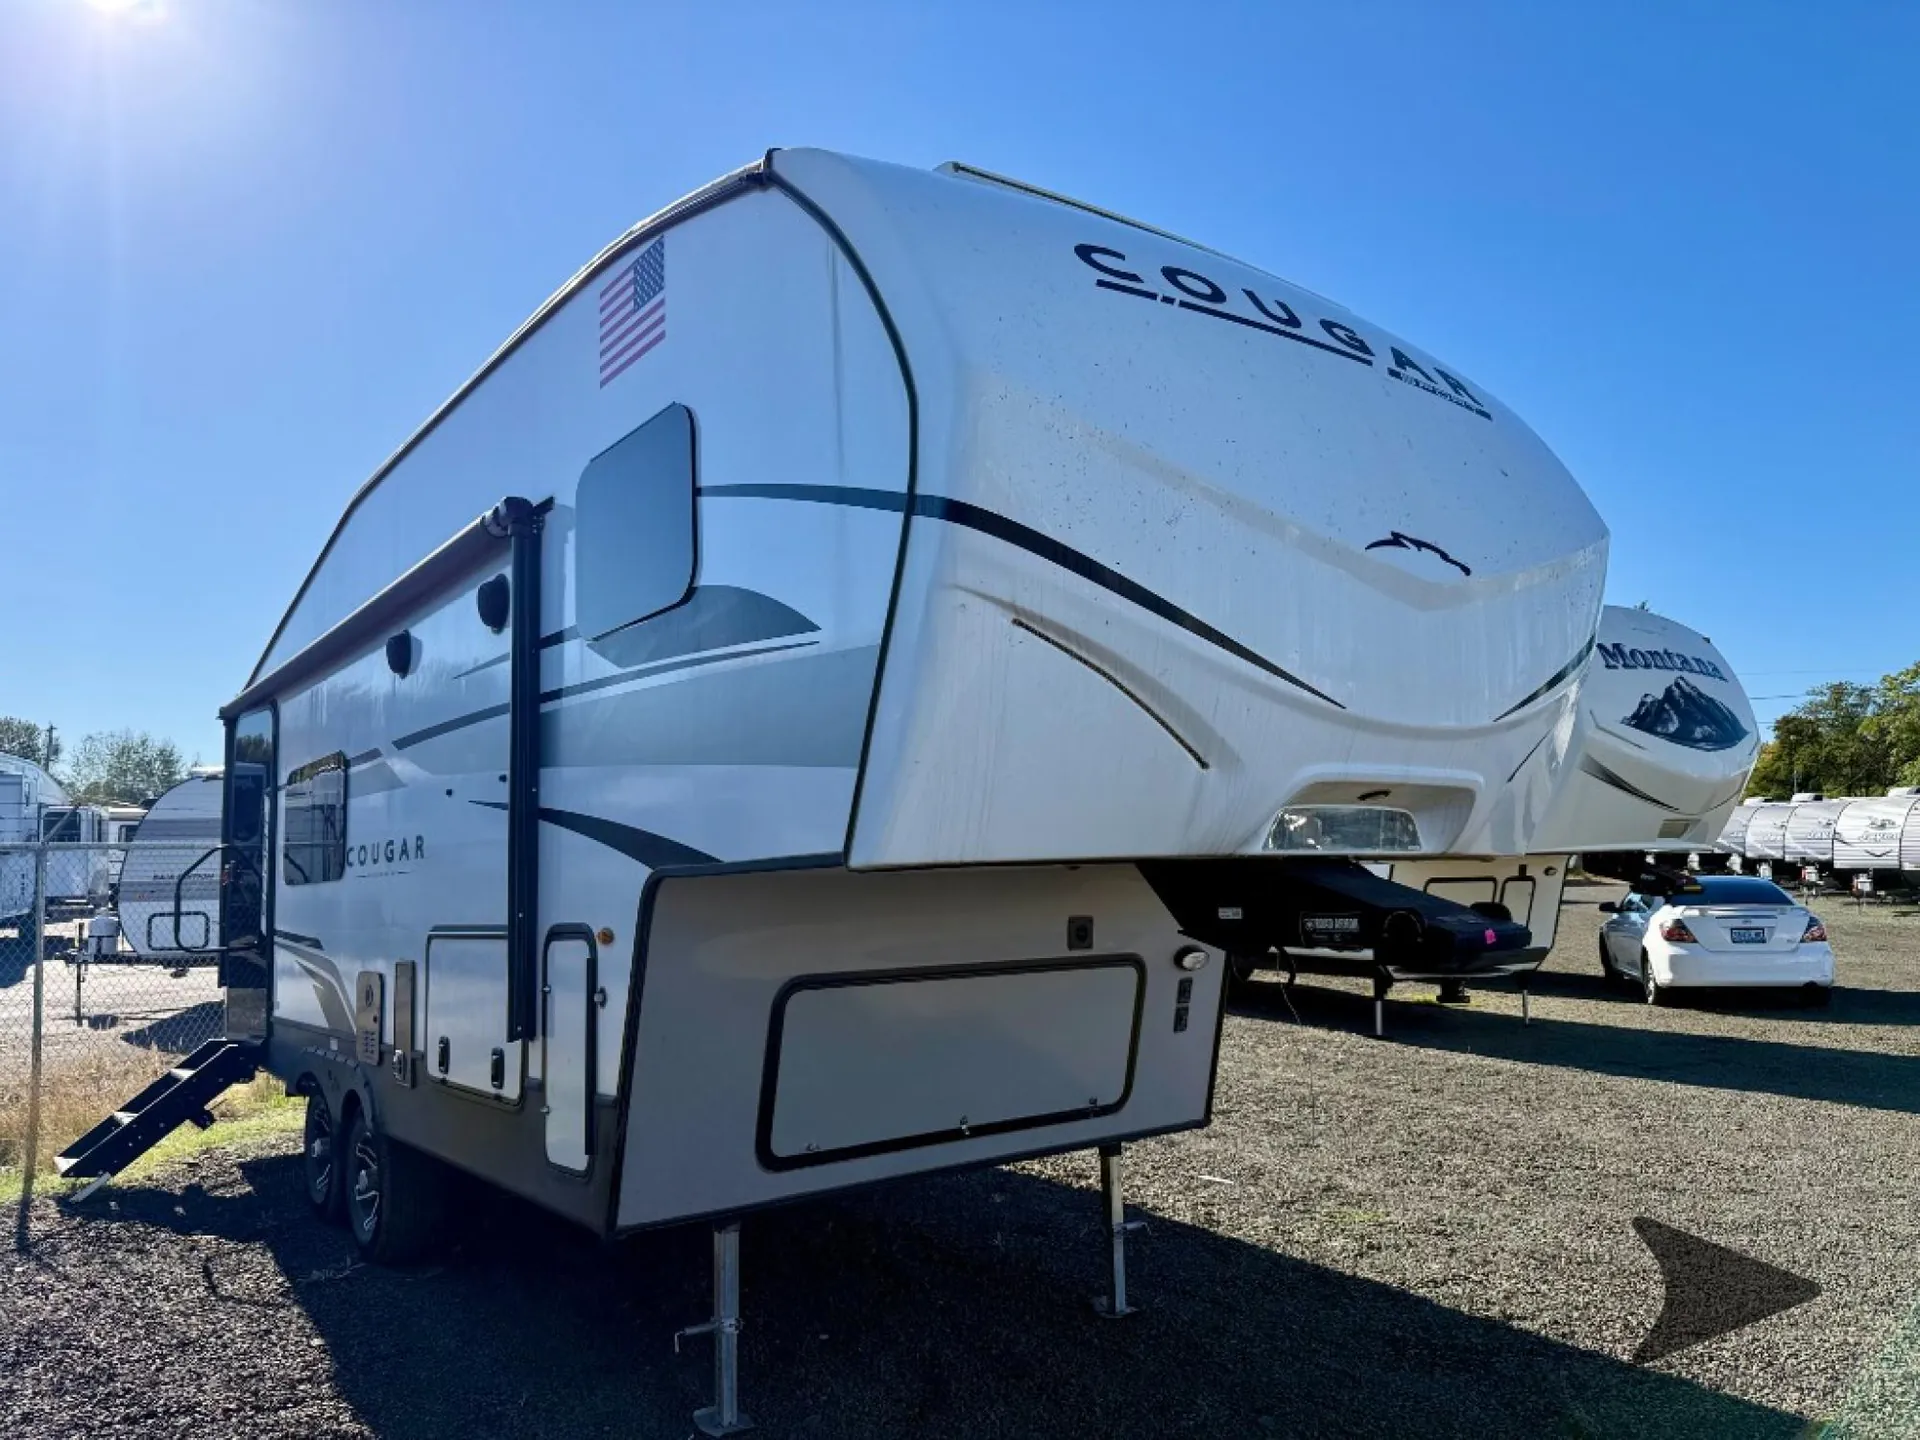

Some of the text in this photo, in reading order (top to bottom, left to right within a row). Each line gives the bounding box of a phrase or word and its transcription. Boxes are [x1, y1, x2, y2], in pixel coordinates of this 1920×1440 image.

[1074, 243, 1484, 407] COUGAR
[1596, 642, 1729, 682] Montana
[346, 834, 425, 867] COUGAR
